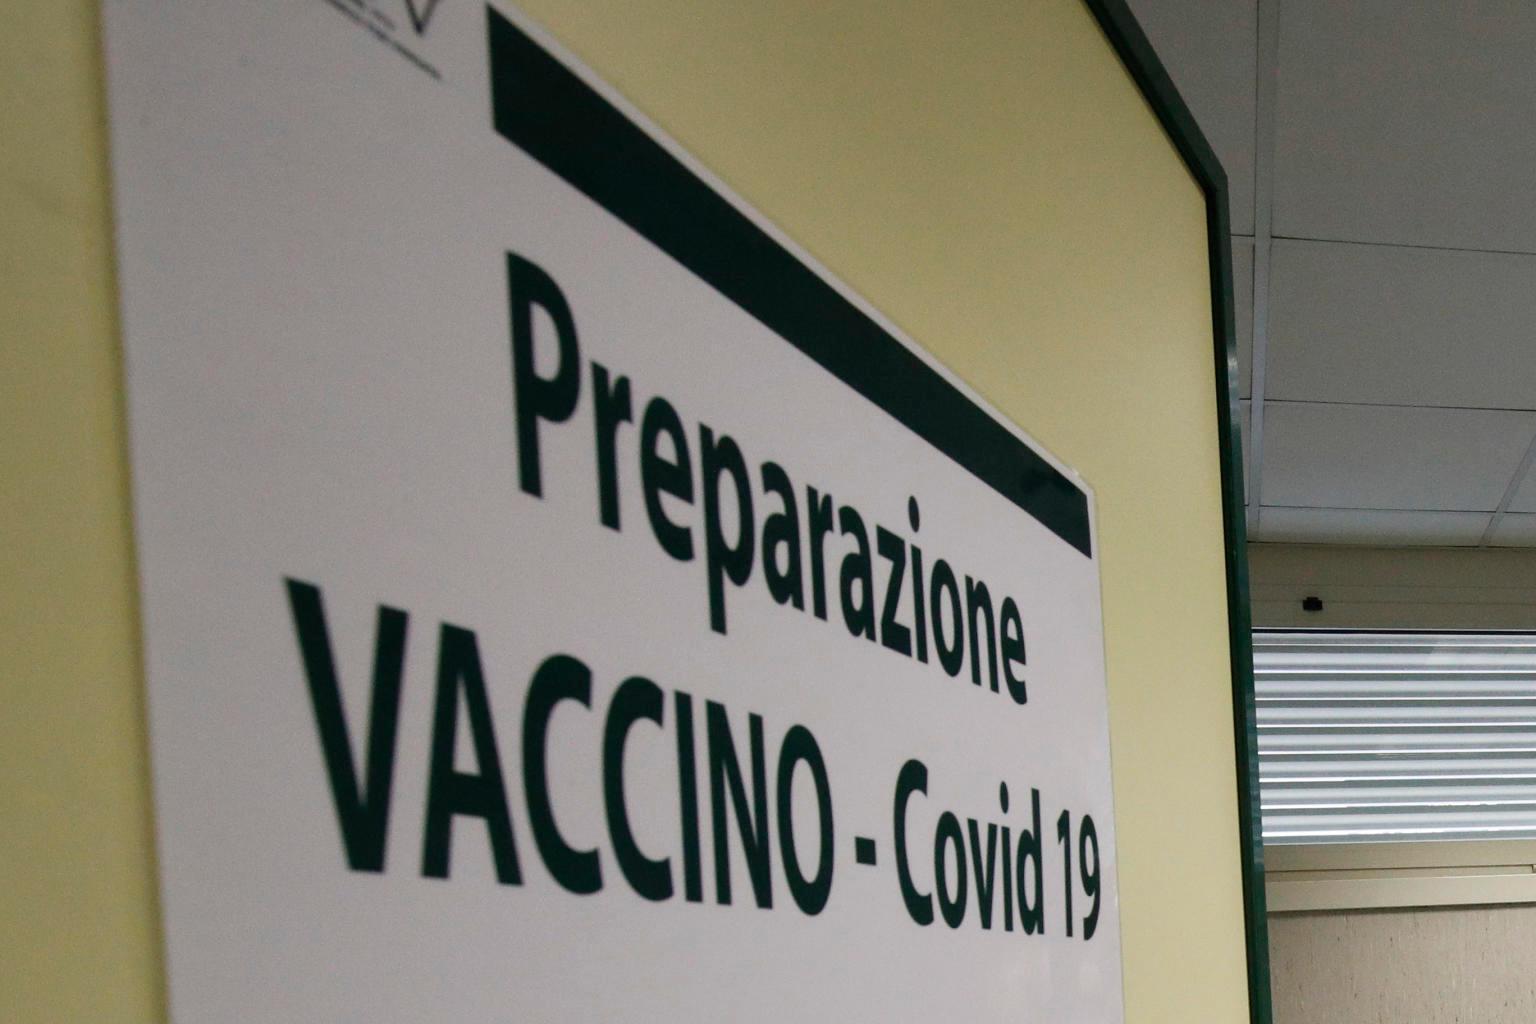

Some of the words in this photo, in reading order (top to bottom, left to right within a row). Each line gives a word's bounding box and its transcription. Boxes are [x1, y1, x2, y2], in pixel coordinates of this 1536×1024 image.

[506, 251, 1028, 706] Preparazione
[284, 577, 834, 916] VACCINO
[893, 759, 1044, 935] Covid
[1057, 809, 1101, 941] 19
